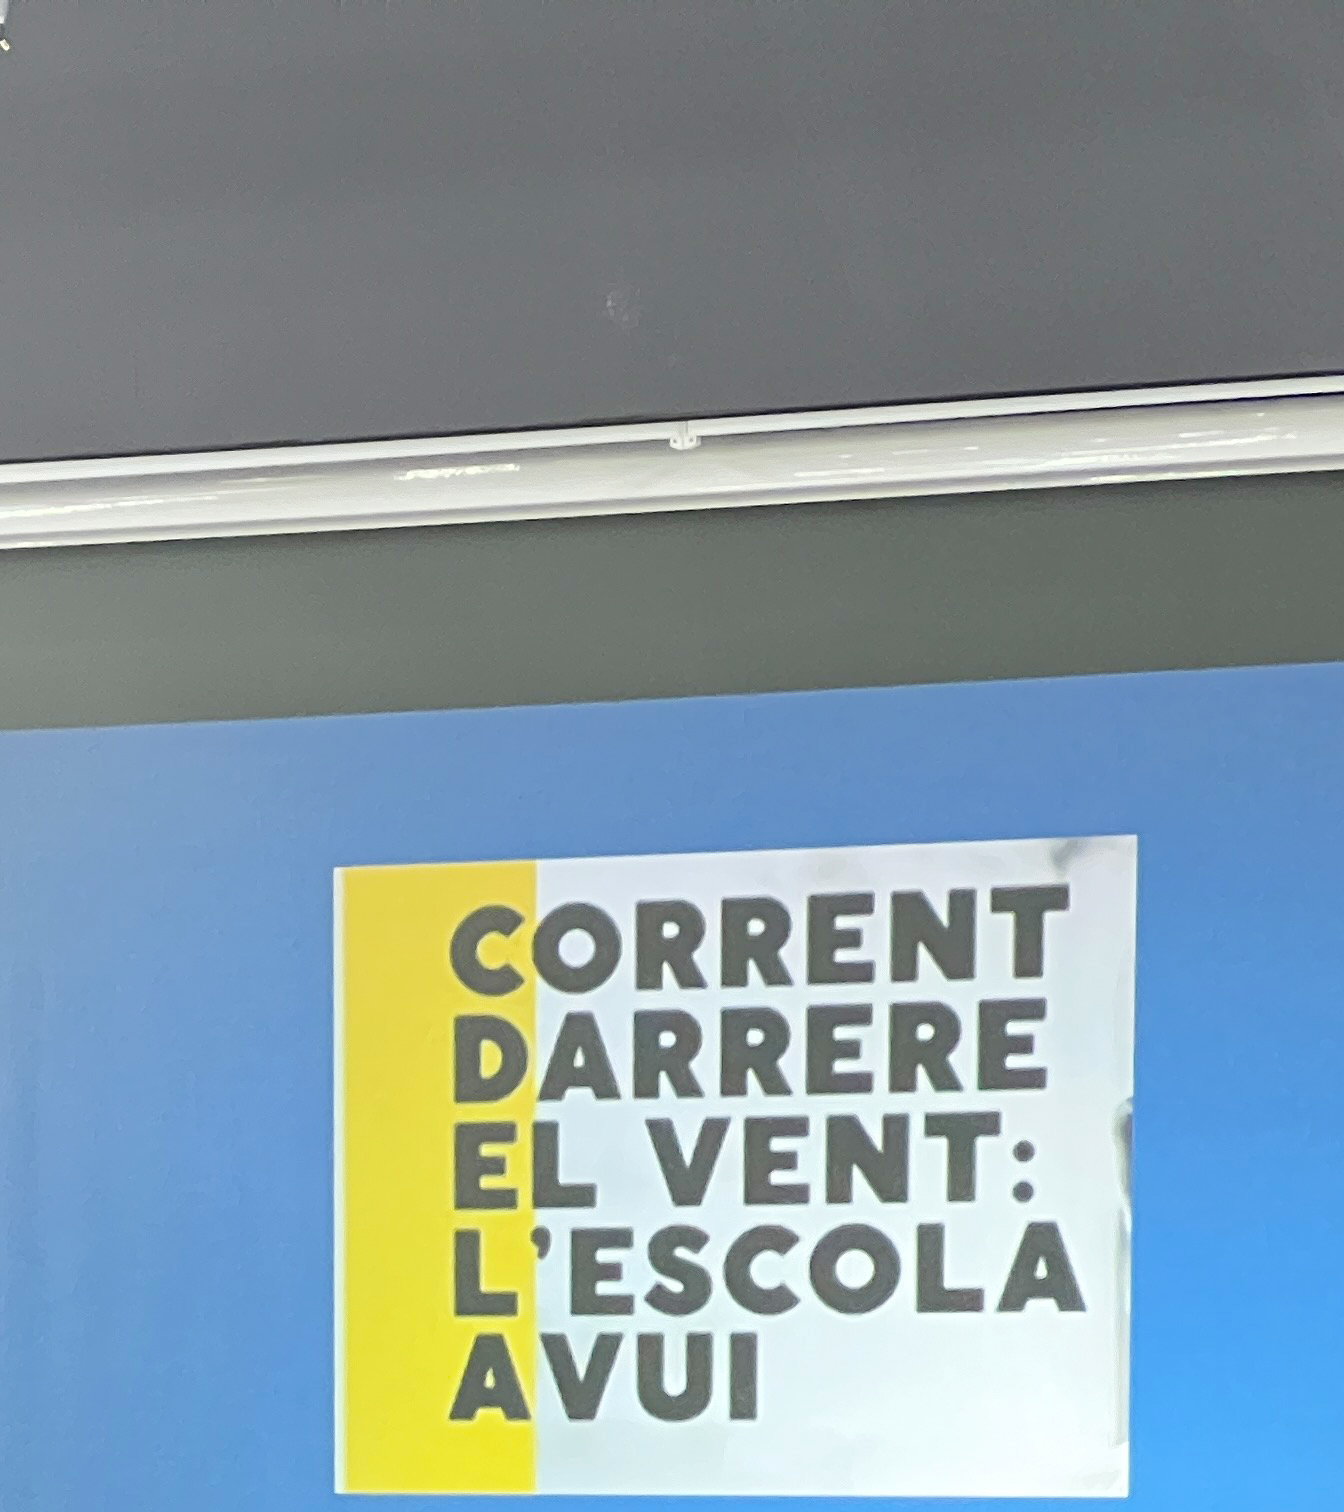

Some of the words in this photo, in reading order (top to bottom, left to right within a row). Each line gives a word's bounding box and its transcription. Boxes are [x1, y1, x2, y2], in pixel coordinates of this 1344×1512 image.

[449, 885, 1070, 996] CORRENT
[453, 998, 1047, 1103] DARRERE
[453, 1121, 597, 1209] EL
[645, 1111, 1035, 1206] VENT:
[453, 1221, 1086, 1317] L'ESCOLA
[448, 1333, 758, 1421] AVUI
